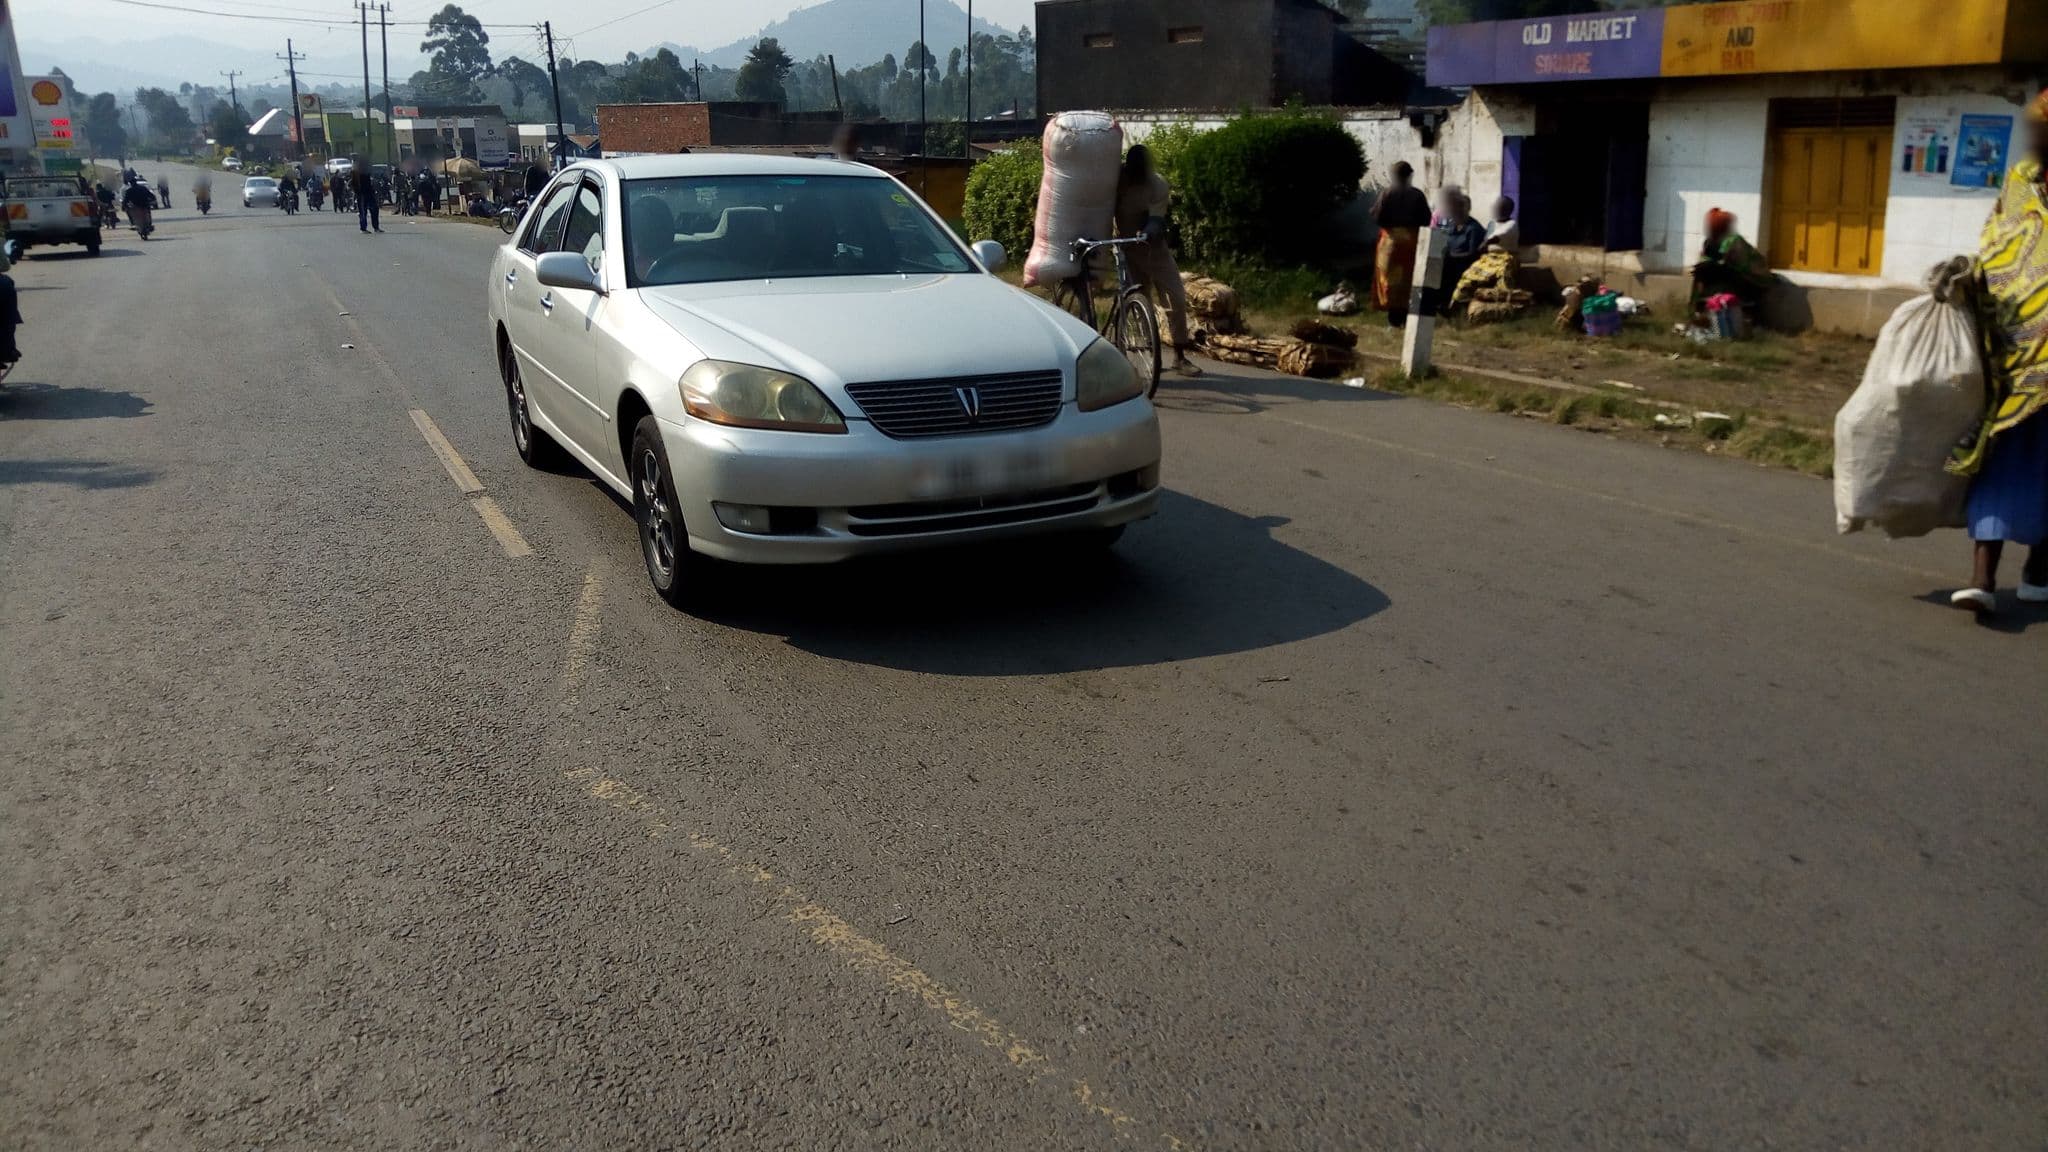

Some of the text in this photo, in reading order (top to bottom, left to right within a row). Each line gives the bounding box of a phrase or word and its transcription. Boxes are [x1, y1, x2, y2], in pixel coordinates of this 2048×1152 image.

[1523, 16, 1637, 45] OLD MARKET
[1725, 26, 1755, 48] AND
[1721, 50, 1755, 70] BAR
